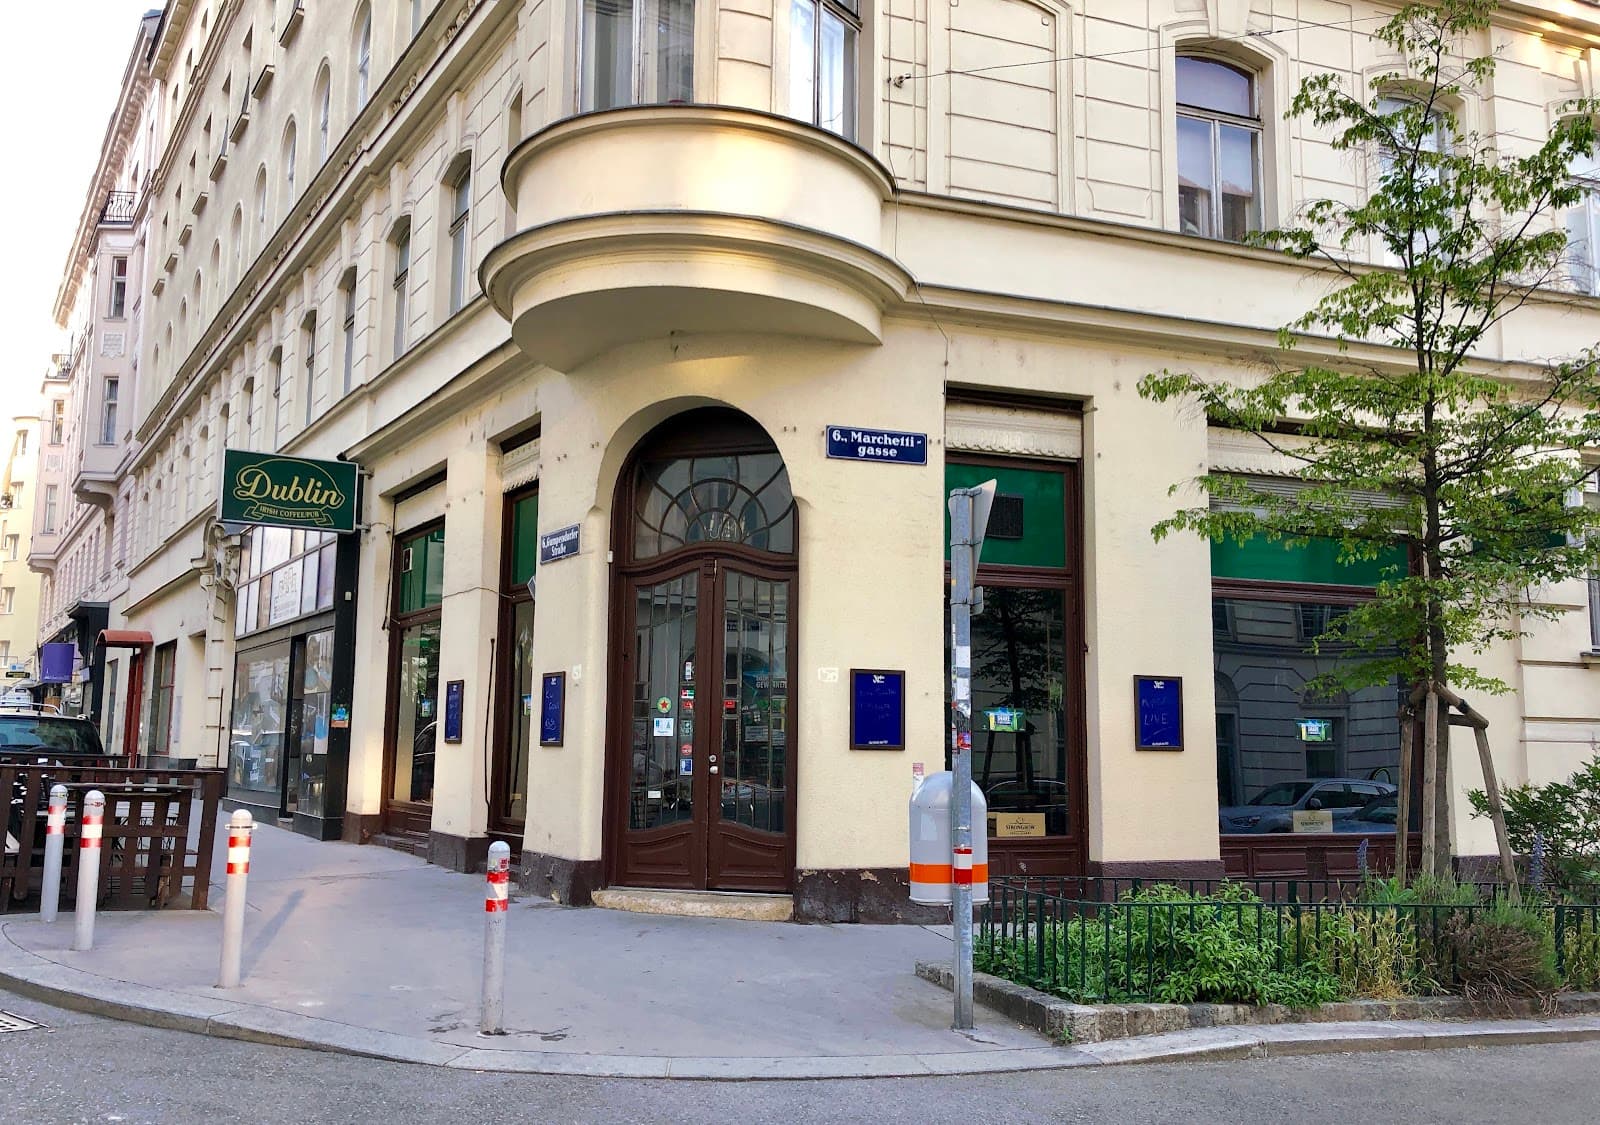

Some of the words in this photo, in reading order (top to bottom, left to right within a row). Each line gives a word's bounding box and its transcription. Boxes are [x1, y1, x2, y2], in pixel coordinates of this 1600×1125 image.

[832, 429, 848, 443] 6.,
[858, 446, 898, 457] gasse
[236, 468, 341, 505] Dublin
[260, 505, 279, 517] IRISH
[551, 543, 567, 556] Straße
